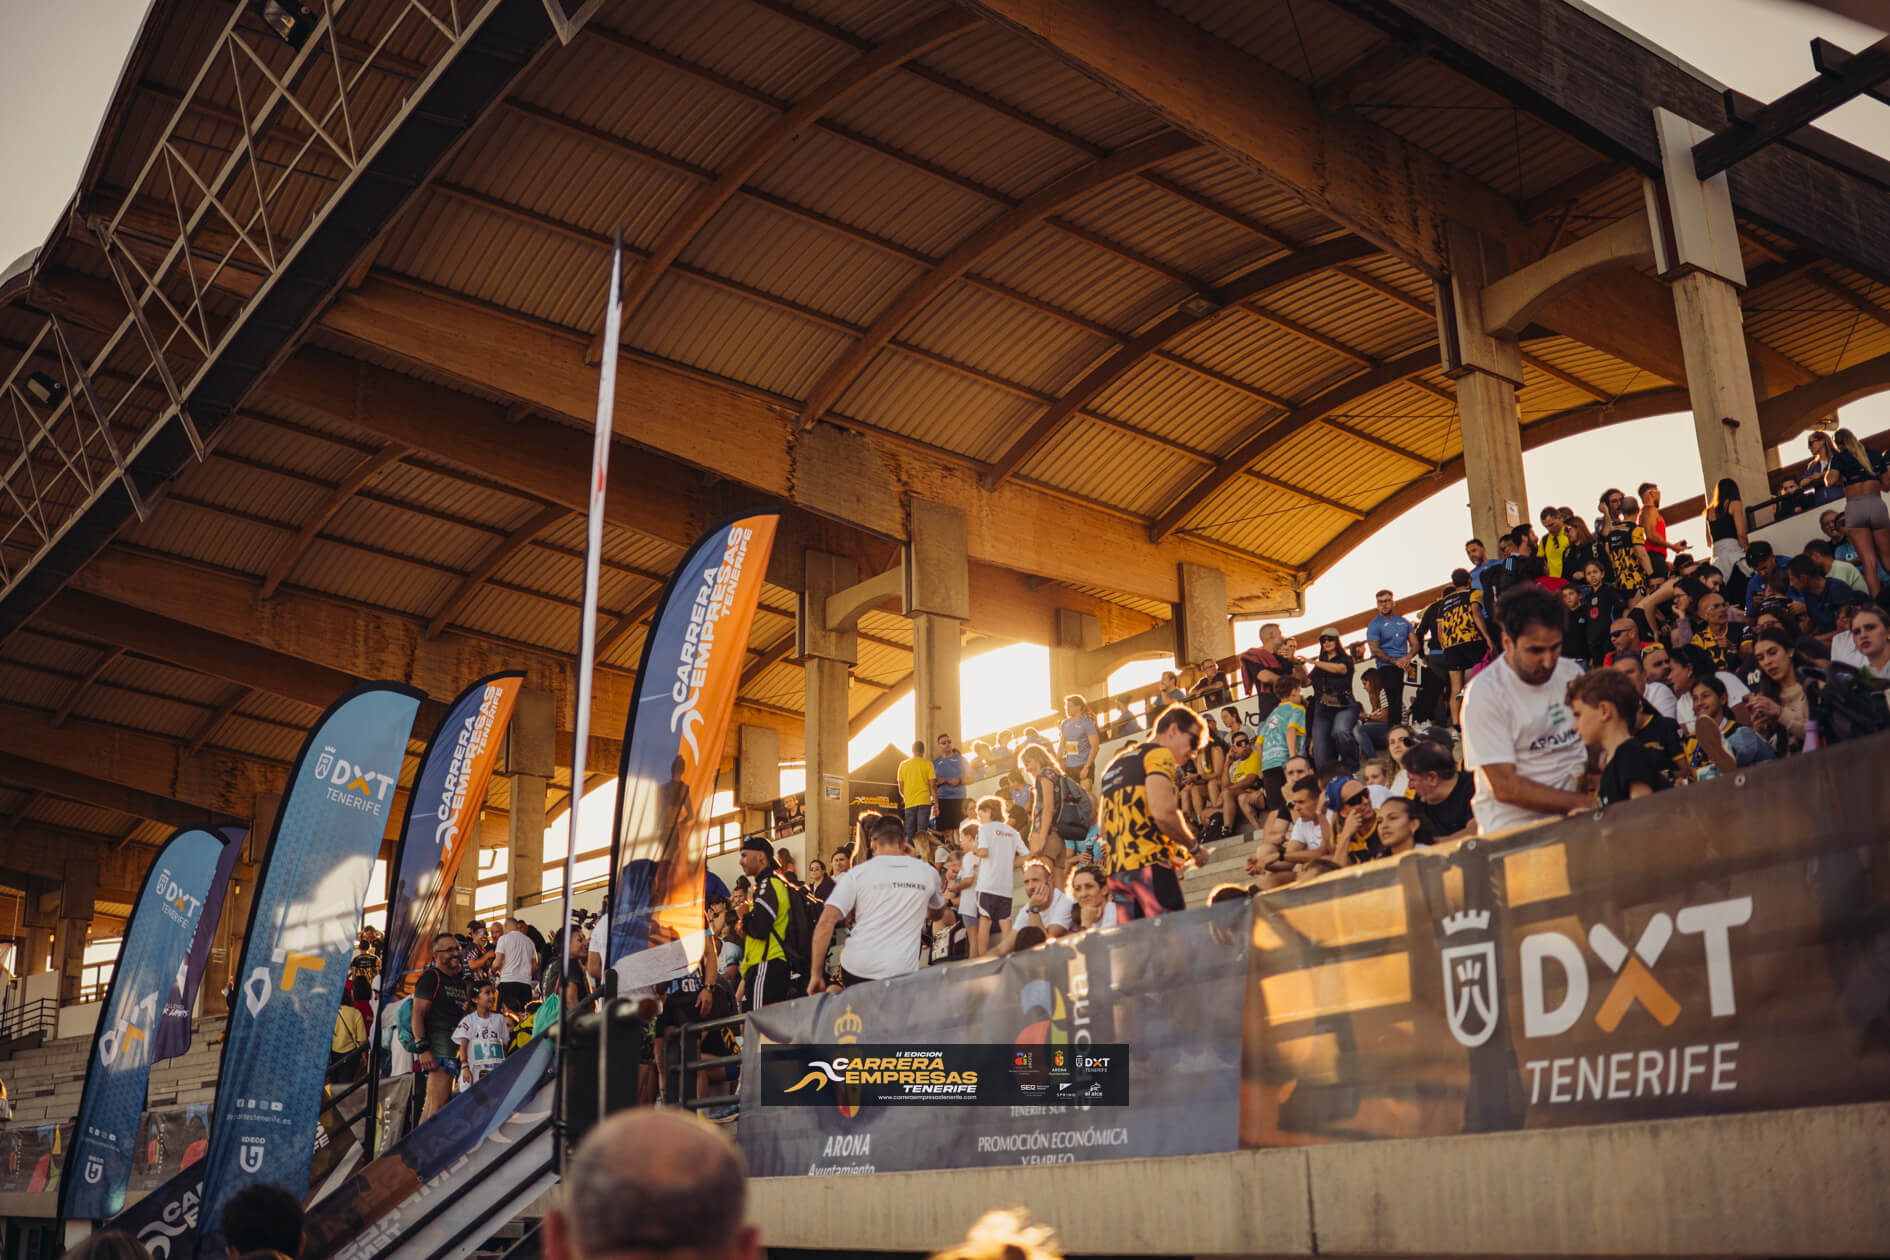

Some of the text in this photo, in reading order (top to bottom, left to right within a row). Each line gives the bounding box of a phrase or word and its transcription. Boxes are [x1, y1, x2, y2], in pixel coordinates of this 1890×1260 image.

[690, 527, 743, 687] EMPRESAS
[721, 528, 752, 617] TENERIFE
[672, 567, 718, 703] CARRERA
[452, 686, 497, 810] EMPRESAS
[477, 687, 503, 756] TENERIFE
[327, 787, 382, 816] TENERIFE
[331, 759, 394, 801] DXT
[437, 715, 475, 821] CARRERA
[1520, 896, 1753, 1038] DXT
[1526, 1042, 1740, 1104] TENERIFE
[822, 1132, 871, 1157] ARONA
[978, 1126, 1129, 1153] PROMOCIÓN ECONÓMICA
